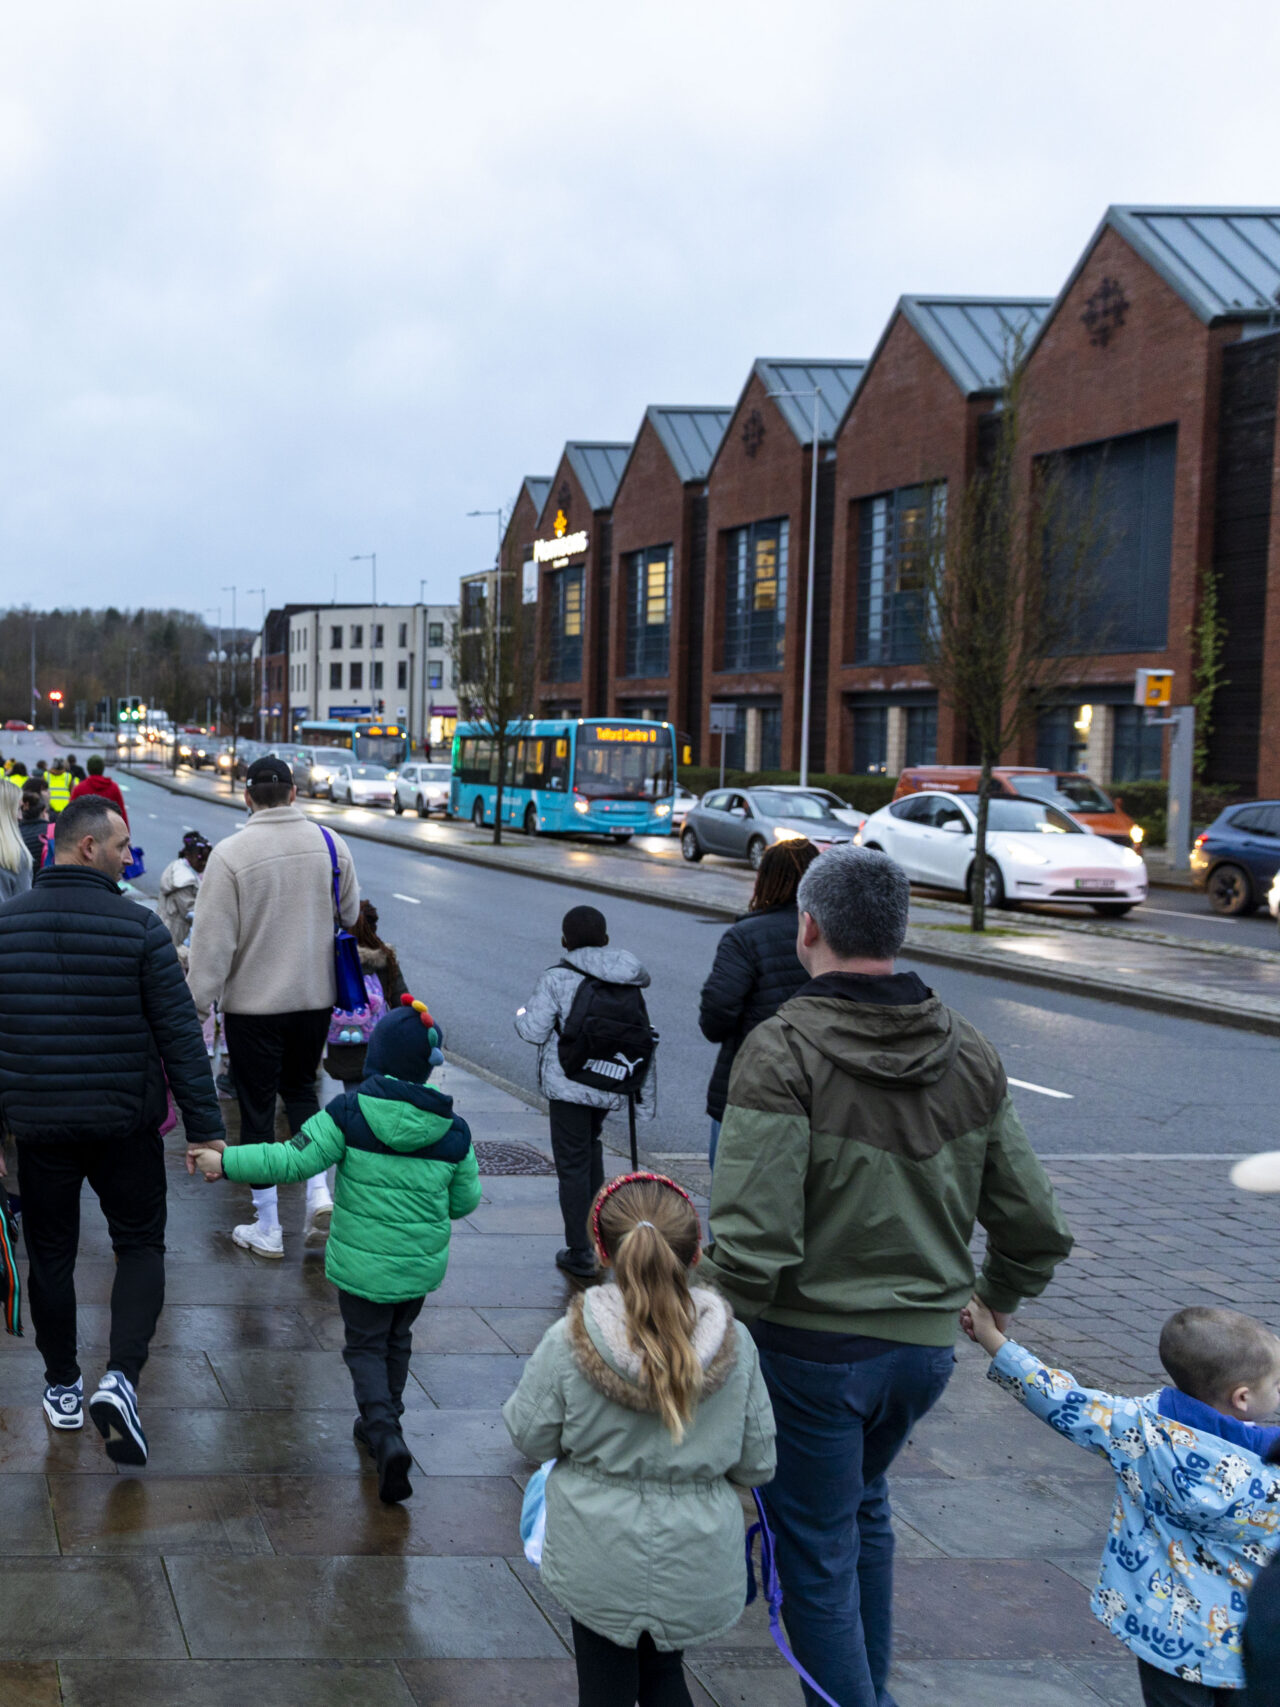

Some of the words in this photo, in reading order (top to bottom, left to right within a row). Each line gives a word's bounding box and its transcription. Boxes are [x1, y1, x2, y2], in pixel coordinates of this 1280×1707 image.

[595, 727, 623, 742] Telford
[582, 1058, 628, 1081] PUMA
[1109, 1537, 1149, 1573] LUEY
[1124, 1614, 1194, 1660] BLUEY
